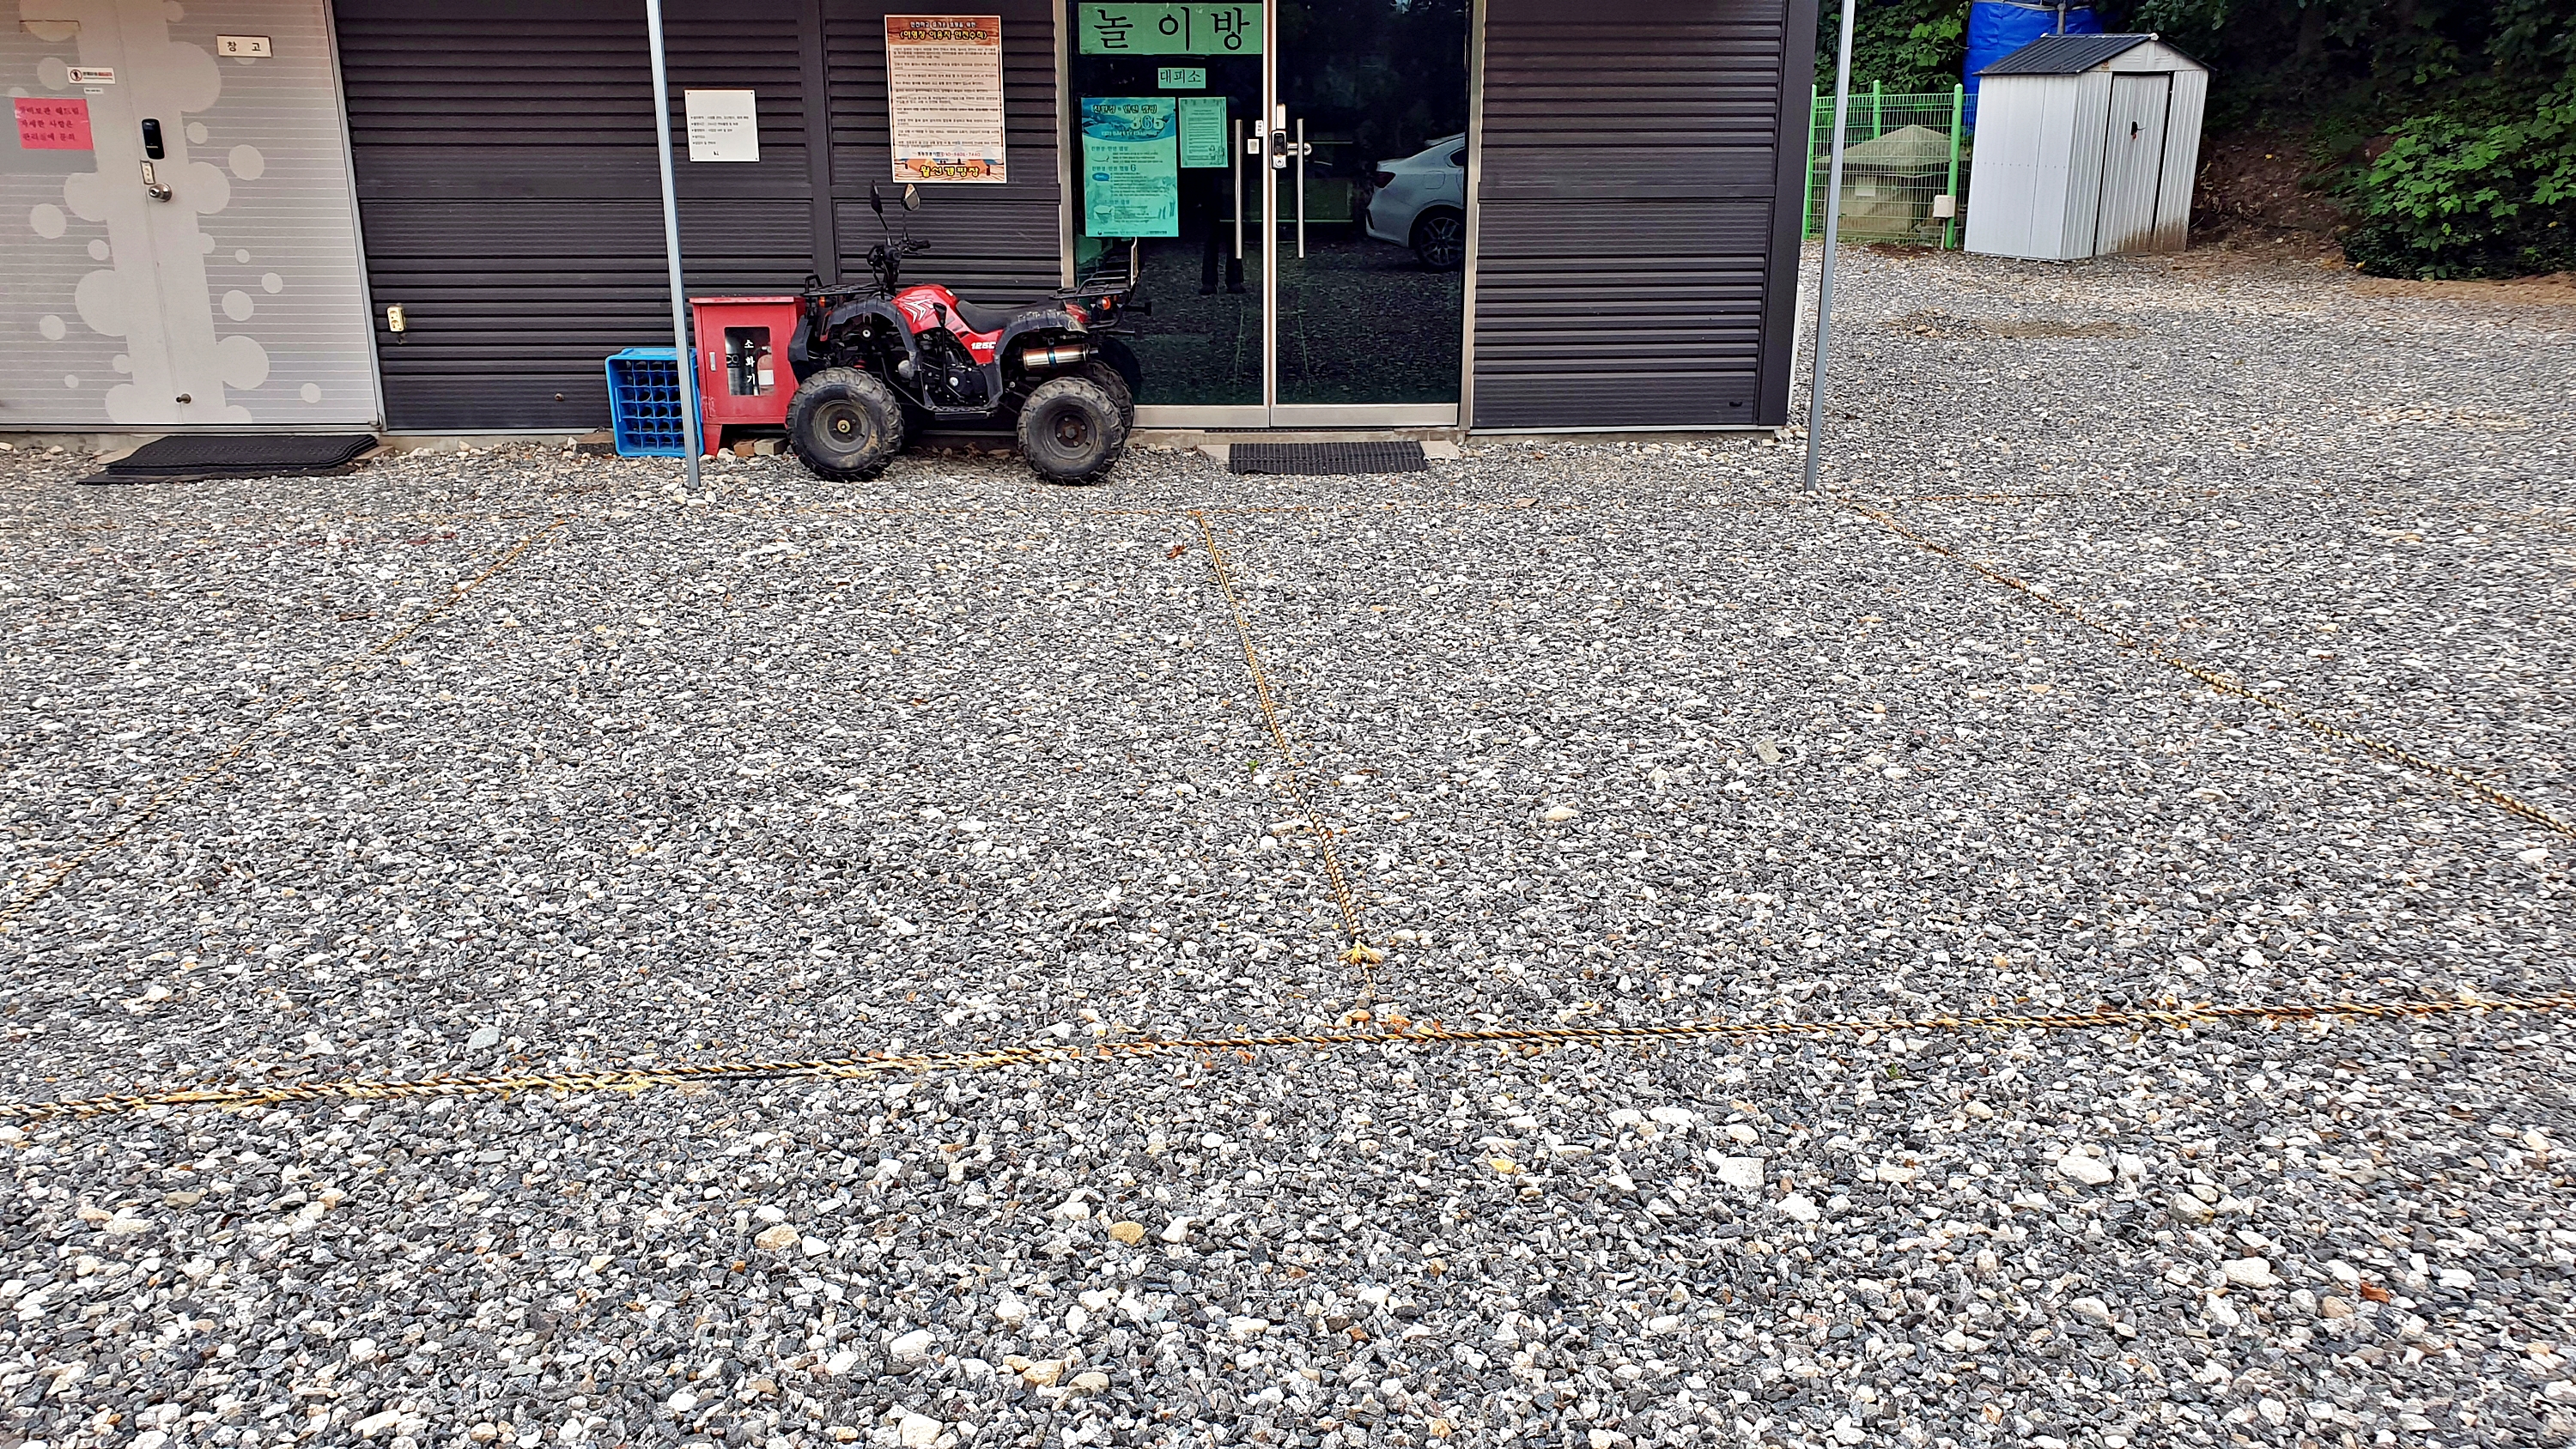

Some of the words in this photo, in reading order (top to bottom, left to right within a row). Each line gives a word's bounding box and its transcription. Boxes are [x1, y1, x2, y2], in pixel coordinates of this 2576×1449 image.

[1093, 6, 1251, 52] 놀이방
[1160, 69, 1202, 84] 대피소
[1130, 114, 1165, 130] 365
[744, 339, 756, 385] 소화기
